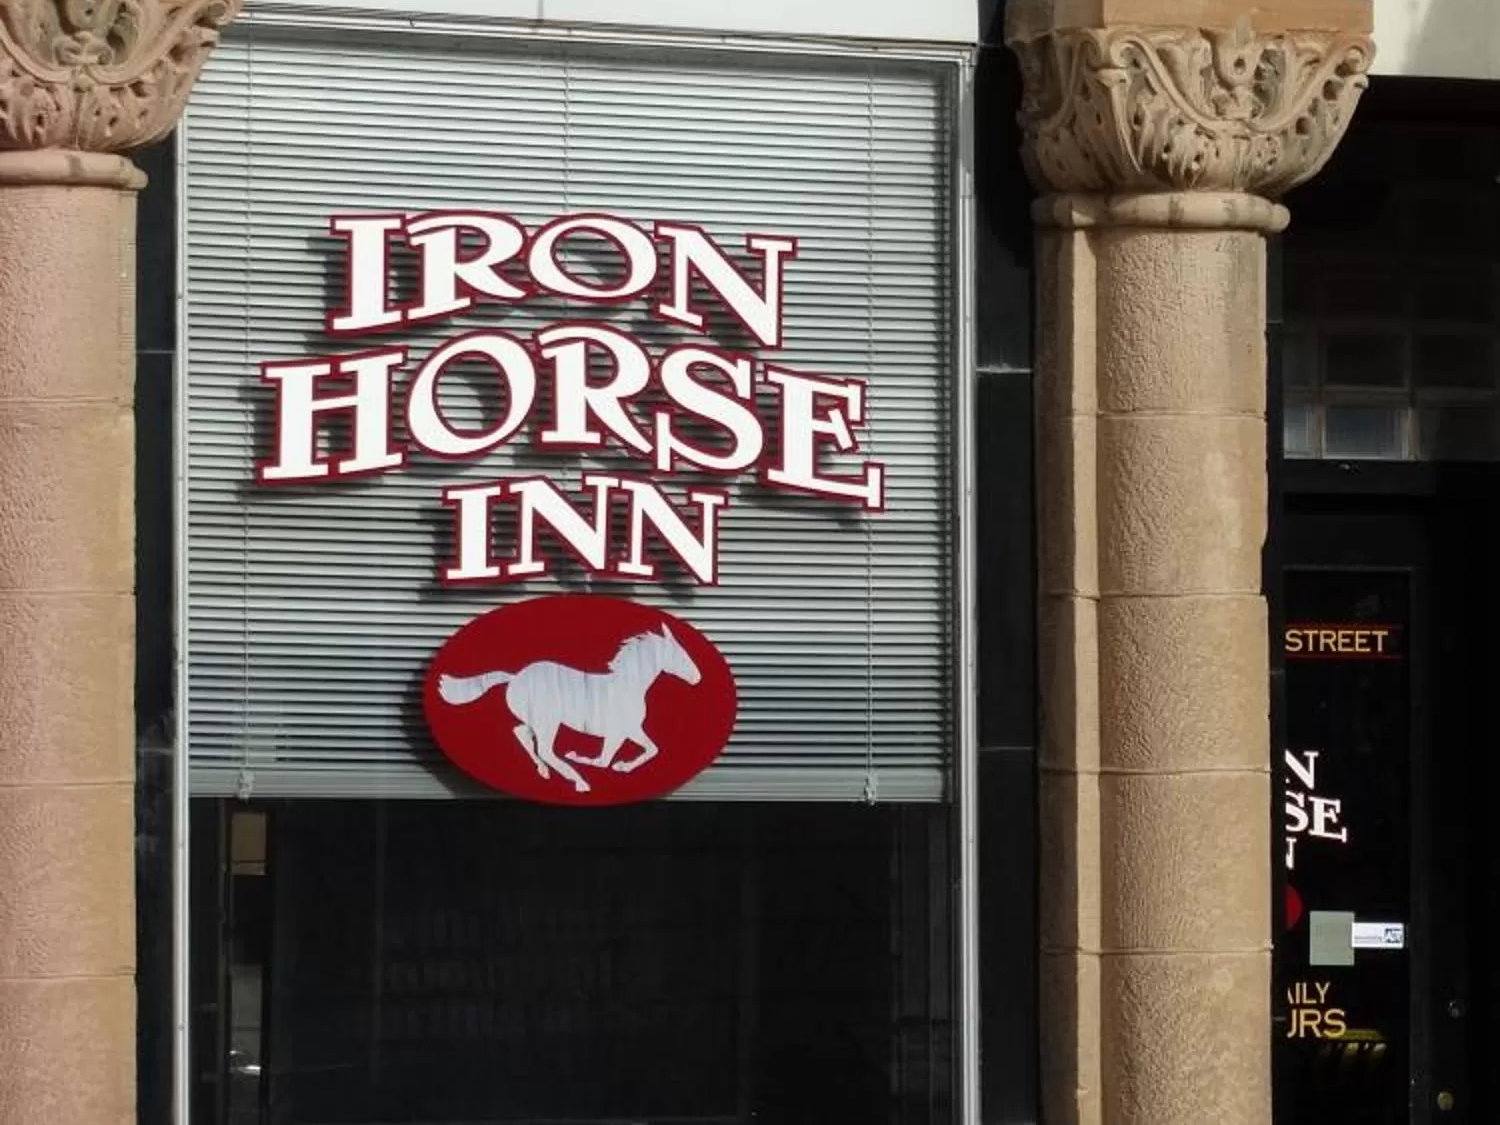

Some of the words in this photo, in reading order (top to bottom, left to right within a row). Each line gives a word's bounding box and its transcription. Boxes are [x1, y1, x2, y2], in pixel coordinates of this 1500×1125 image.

[326, 209, 798, 349] IRON
[256, 319, 885, 512] HORSE
[440, 473, 729, 586] INN
[1284, 629, 1389, 653] STREET
